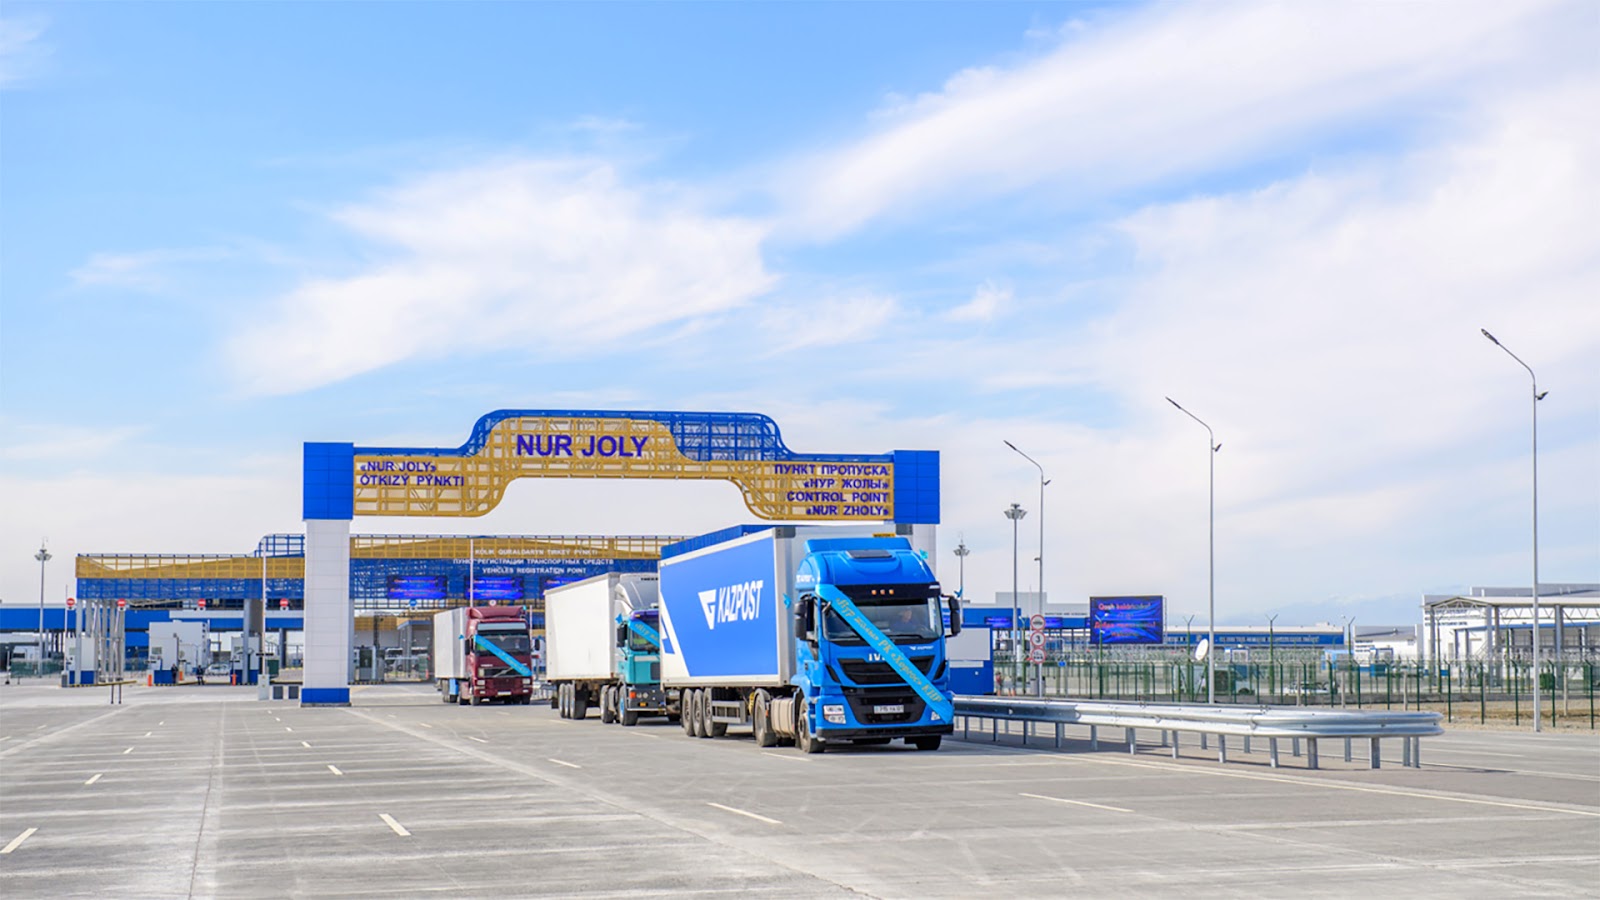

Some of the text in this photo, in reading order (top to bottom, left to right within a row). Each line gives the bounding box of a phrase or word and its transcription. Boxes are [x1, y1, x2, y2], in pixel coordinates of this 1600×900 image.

[517, 434, 649, 457] NUR JOLY
[360, 461, 437, 473] «NUR JOLY»
[774, 463, 889, 476] ПУНКТ ПРОПУСКА
[786, 491, 889, 503] CONTROL POINT
[842, 505, 889, 517] ZHOLY»
[717, 579, 763, 624] KAZPOST
